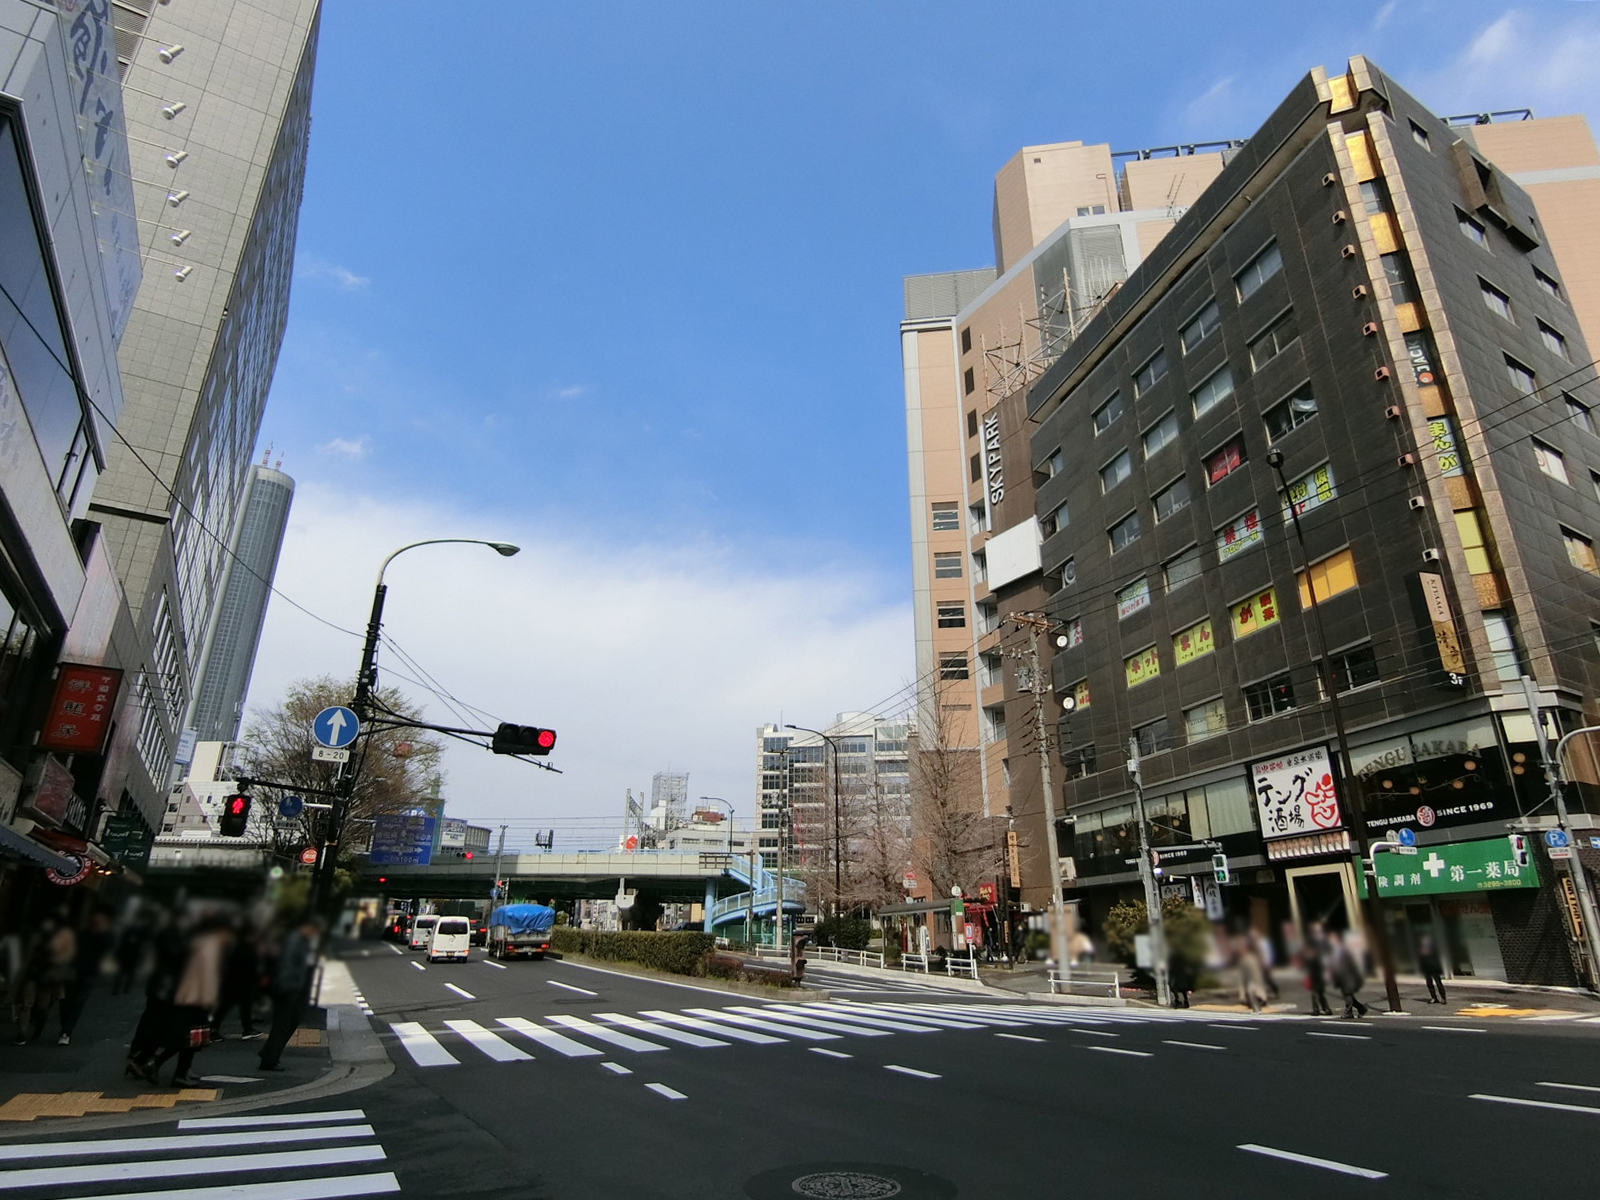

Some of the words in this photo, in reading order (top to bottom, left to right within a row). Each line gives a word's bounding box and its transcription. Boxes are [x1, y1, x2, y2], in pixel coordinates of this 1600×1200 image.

[1407, 340, 1430, 372] JACK
[985, 411, 1004, 505] SKYPARK
[1428, 421, 1457, 470] まんが
[1131, 650, 1159, 674] ネット
[1356, 747, 1407, 782] TENGU
[1411, 740, 1483, 759] SAKABA
[1258, 767, 1313, 807] テング
[1268, 804, 1305, 832] 酒場
[1366, 818, 1388, 828] TENGU
[1389, 814, 1416, 825] SAKABA
[1436, 805, 1467, 817] SINCE
[1468, 801, 1494, 812] 1969
[1549, 833, 1559, 845] P
[1450, 860, 1520, 882] 第一薬局
